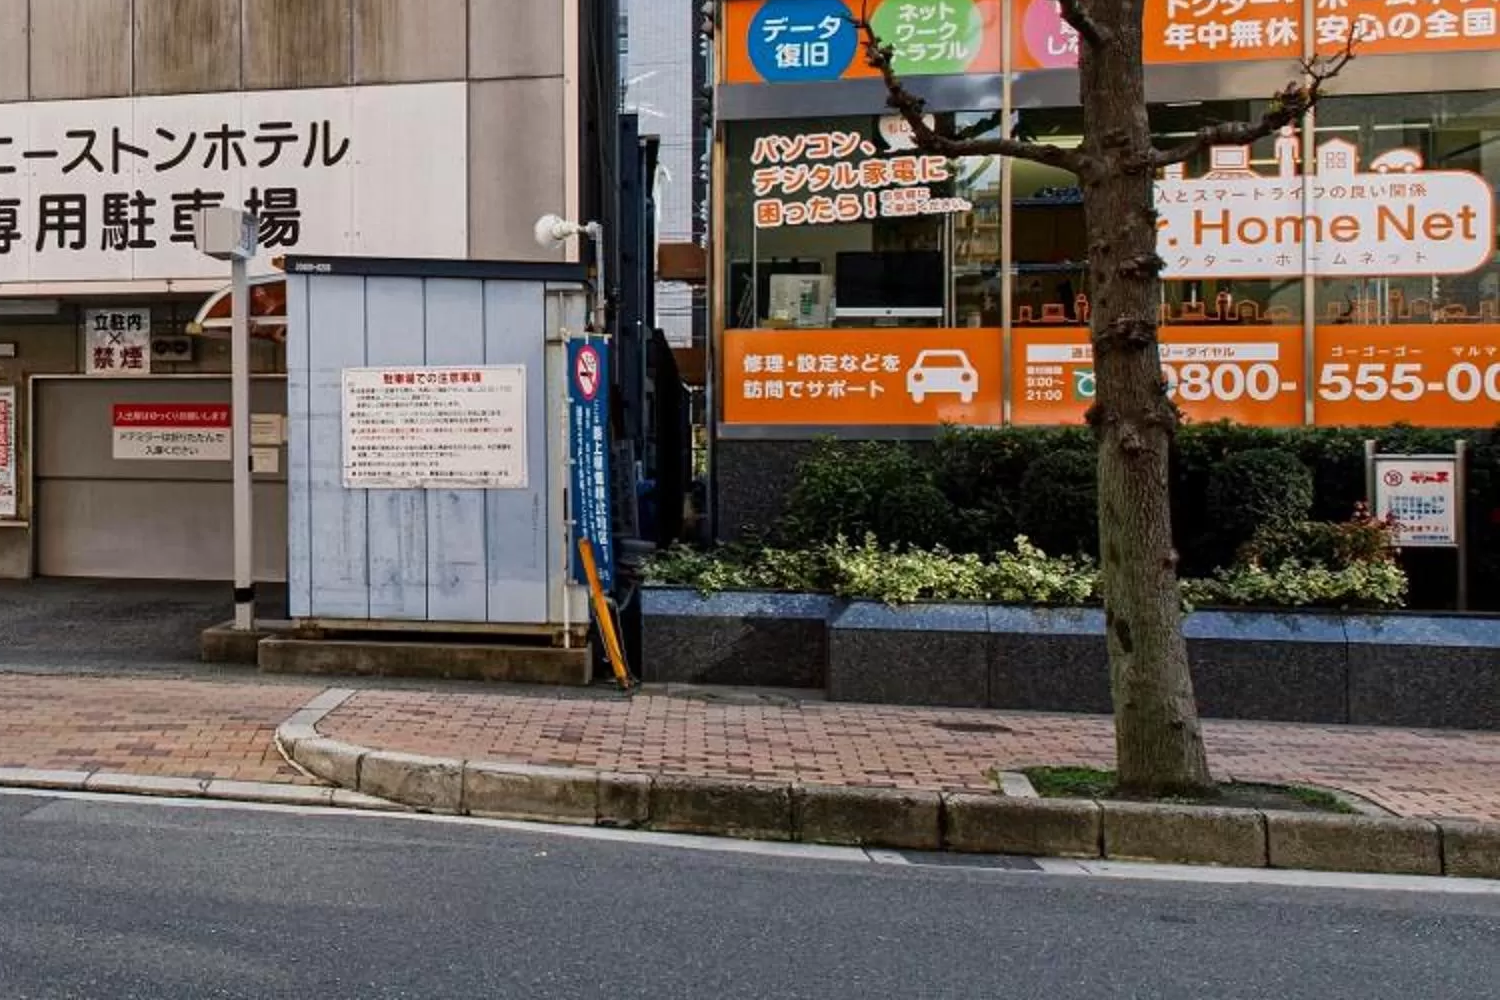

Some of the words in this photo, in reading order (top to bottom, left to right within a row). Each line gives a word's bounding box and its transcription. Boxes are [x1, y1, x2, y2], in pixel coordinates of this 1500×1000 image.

[900, 1, 956, 21] ネット
[762, 14, 842, 43] データ
[896, 22, 957, 42] ワーク
[1164, 17, 1298, 50] 年中無休
[1315, 6, 1497, 45] 安心の全国
[775, 41, 829, 68] 復旧
[751, 130, 876, 165] パソコン、
[753, 156, 948, 194] デジタル家電に
[1193, 208, 1360, 246] Home
[1377, 204, 1477, 241] Net
[94, 314, 142, 331] 立駐内
[94, 346, 143, 369] 禁煙
[743, 354, 900, 373] 修理・設定などを
[743, 380, 886, 399] 訪問でサポート
